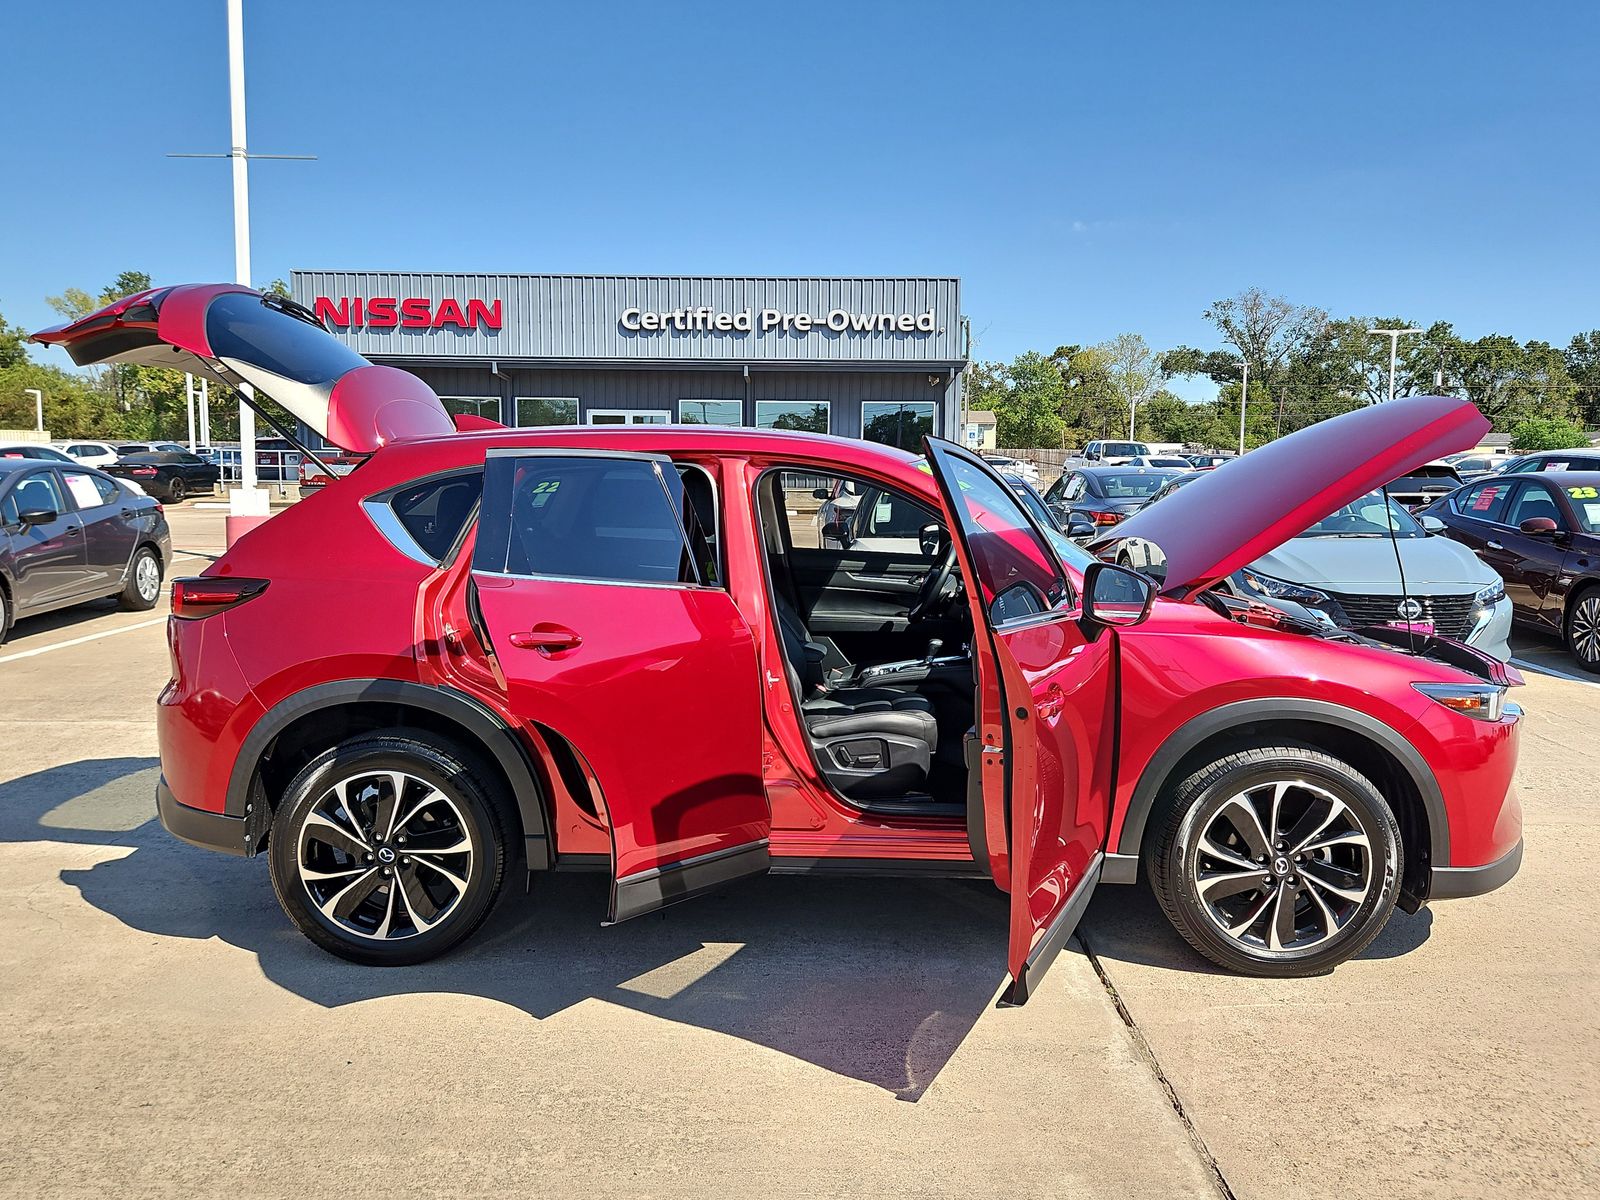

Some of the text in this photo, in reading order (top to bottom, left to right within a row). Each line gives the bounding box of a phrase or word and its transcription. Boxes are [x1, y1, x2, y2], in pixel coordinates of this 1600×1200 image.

[315, 296, 503, 328] NISSAN
[621, 306, 936, 332] Certified Pre-Owned
[532, 481, 560, 493] 22
[1567, 486, 1599, 499] 23
